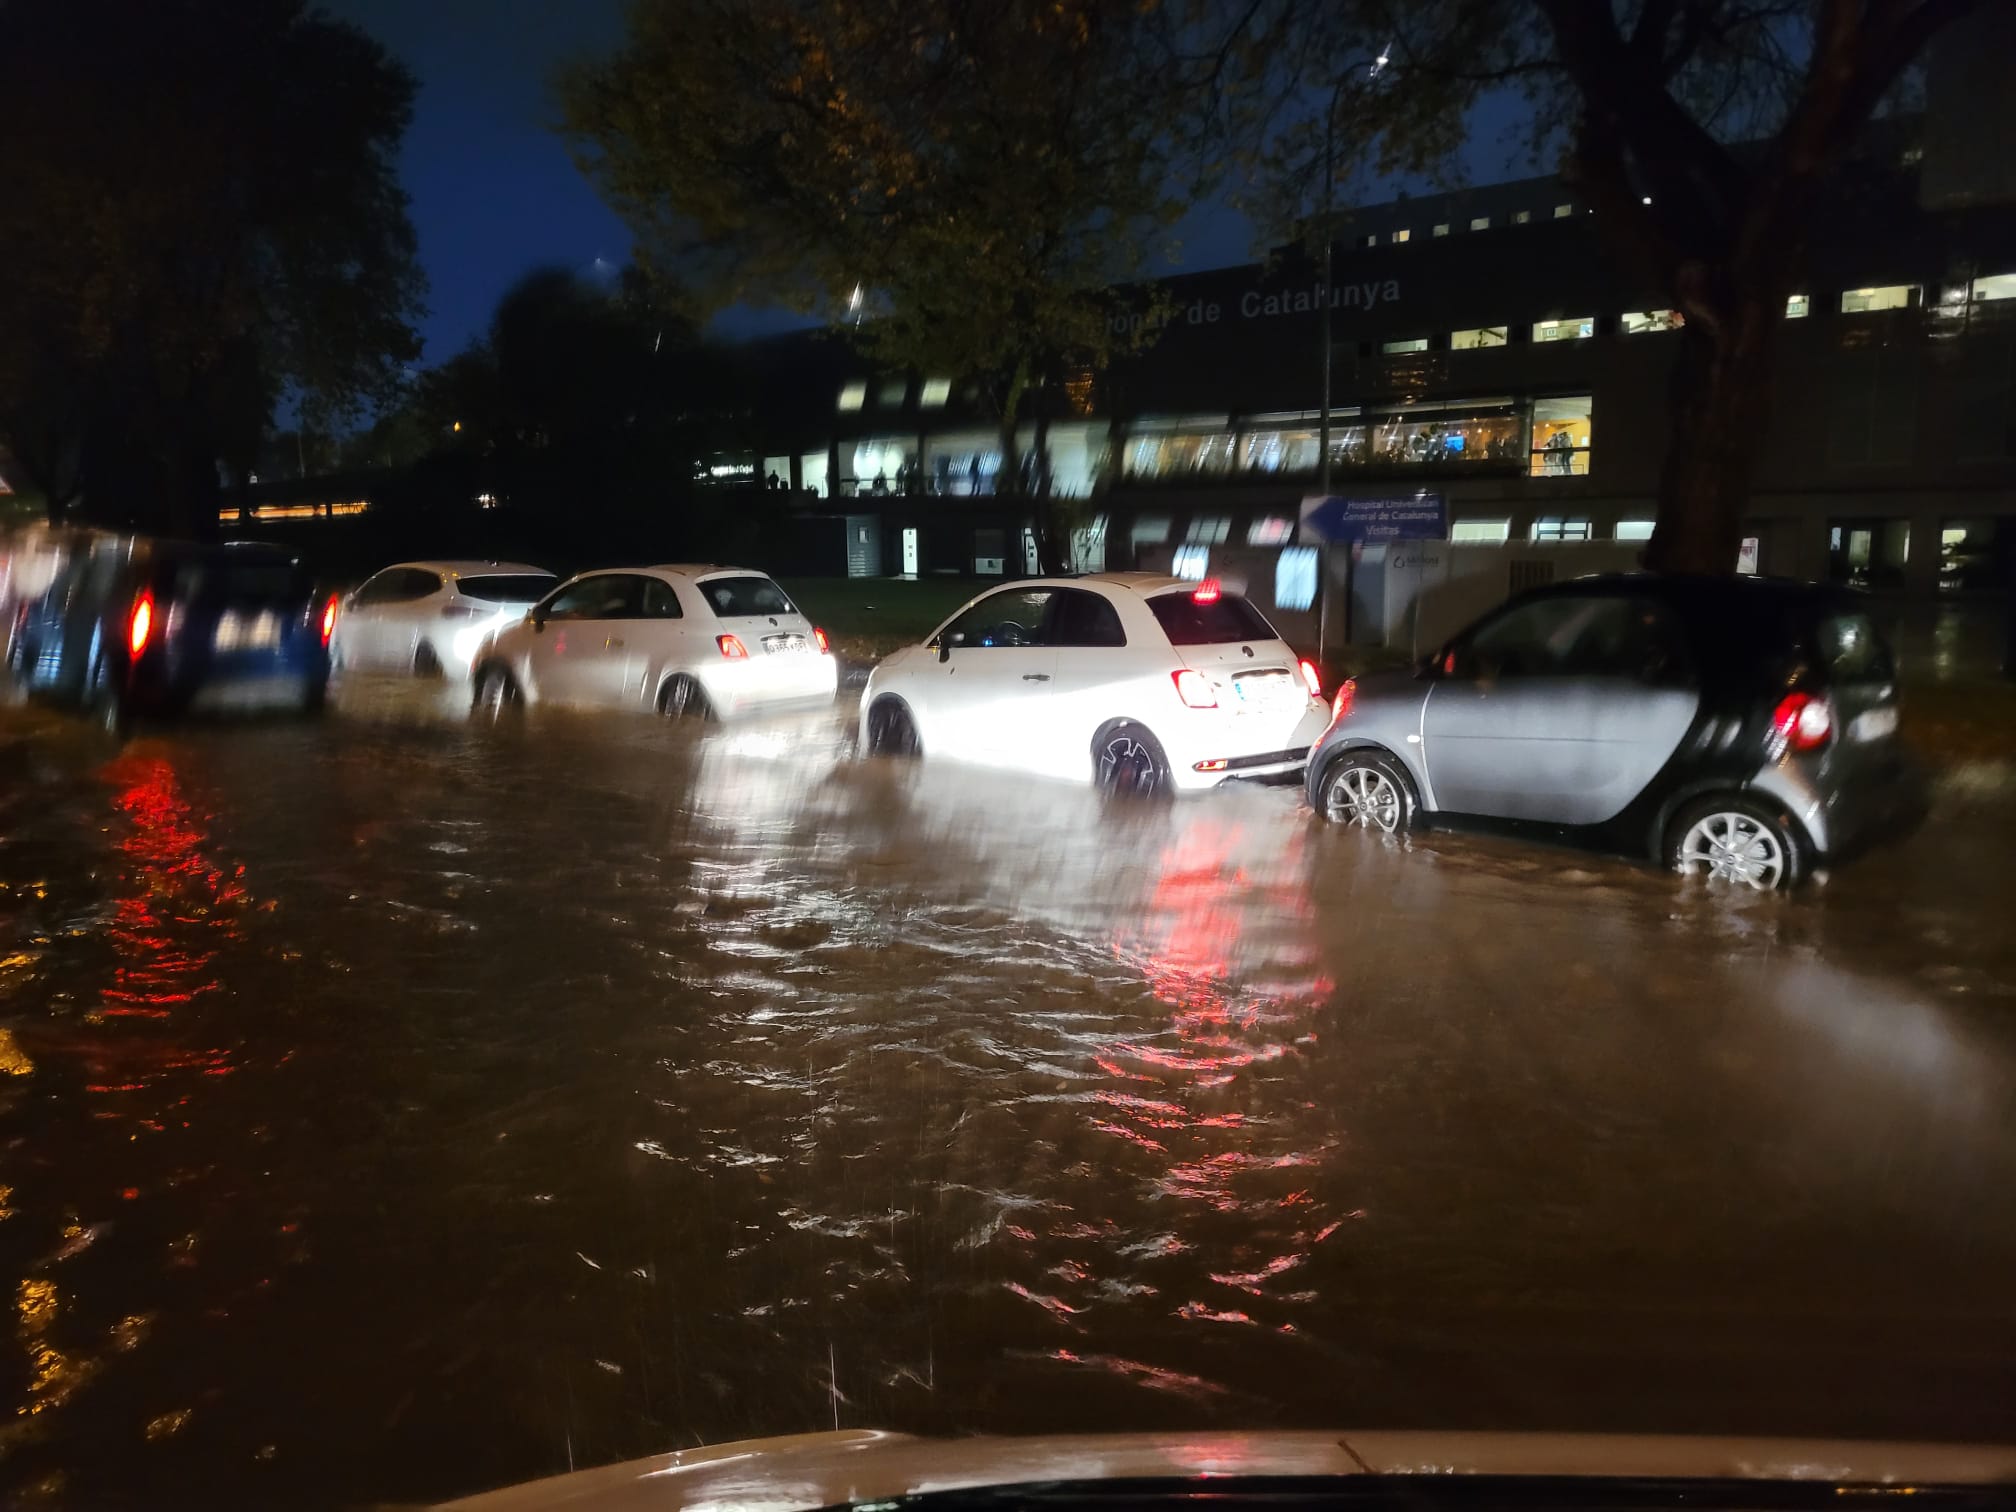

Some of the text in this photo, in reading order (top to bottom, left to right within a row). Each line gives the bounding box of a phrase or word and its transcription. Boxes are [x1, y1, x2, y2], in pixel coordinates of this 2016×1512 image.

[1187, 298, 1221, 325] de
[1241, 279, 1401, 318] Catalunya
[1347, 500, 1384, 510] Hospital
[1343, 511, 1439, 521] General de Catalunya
